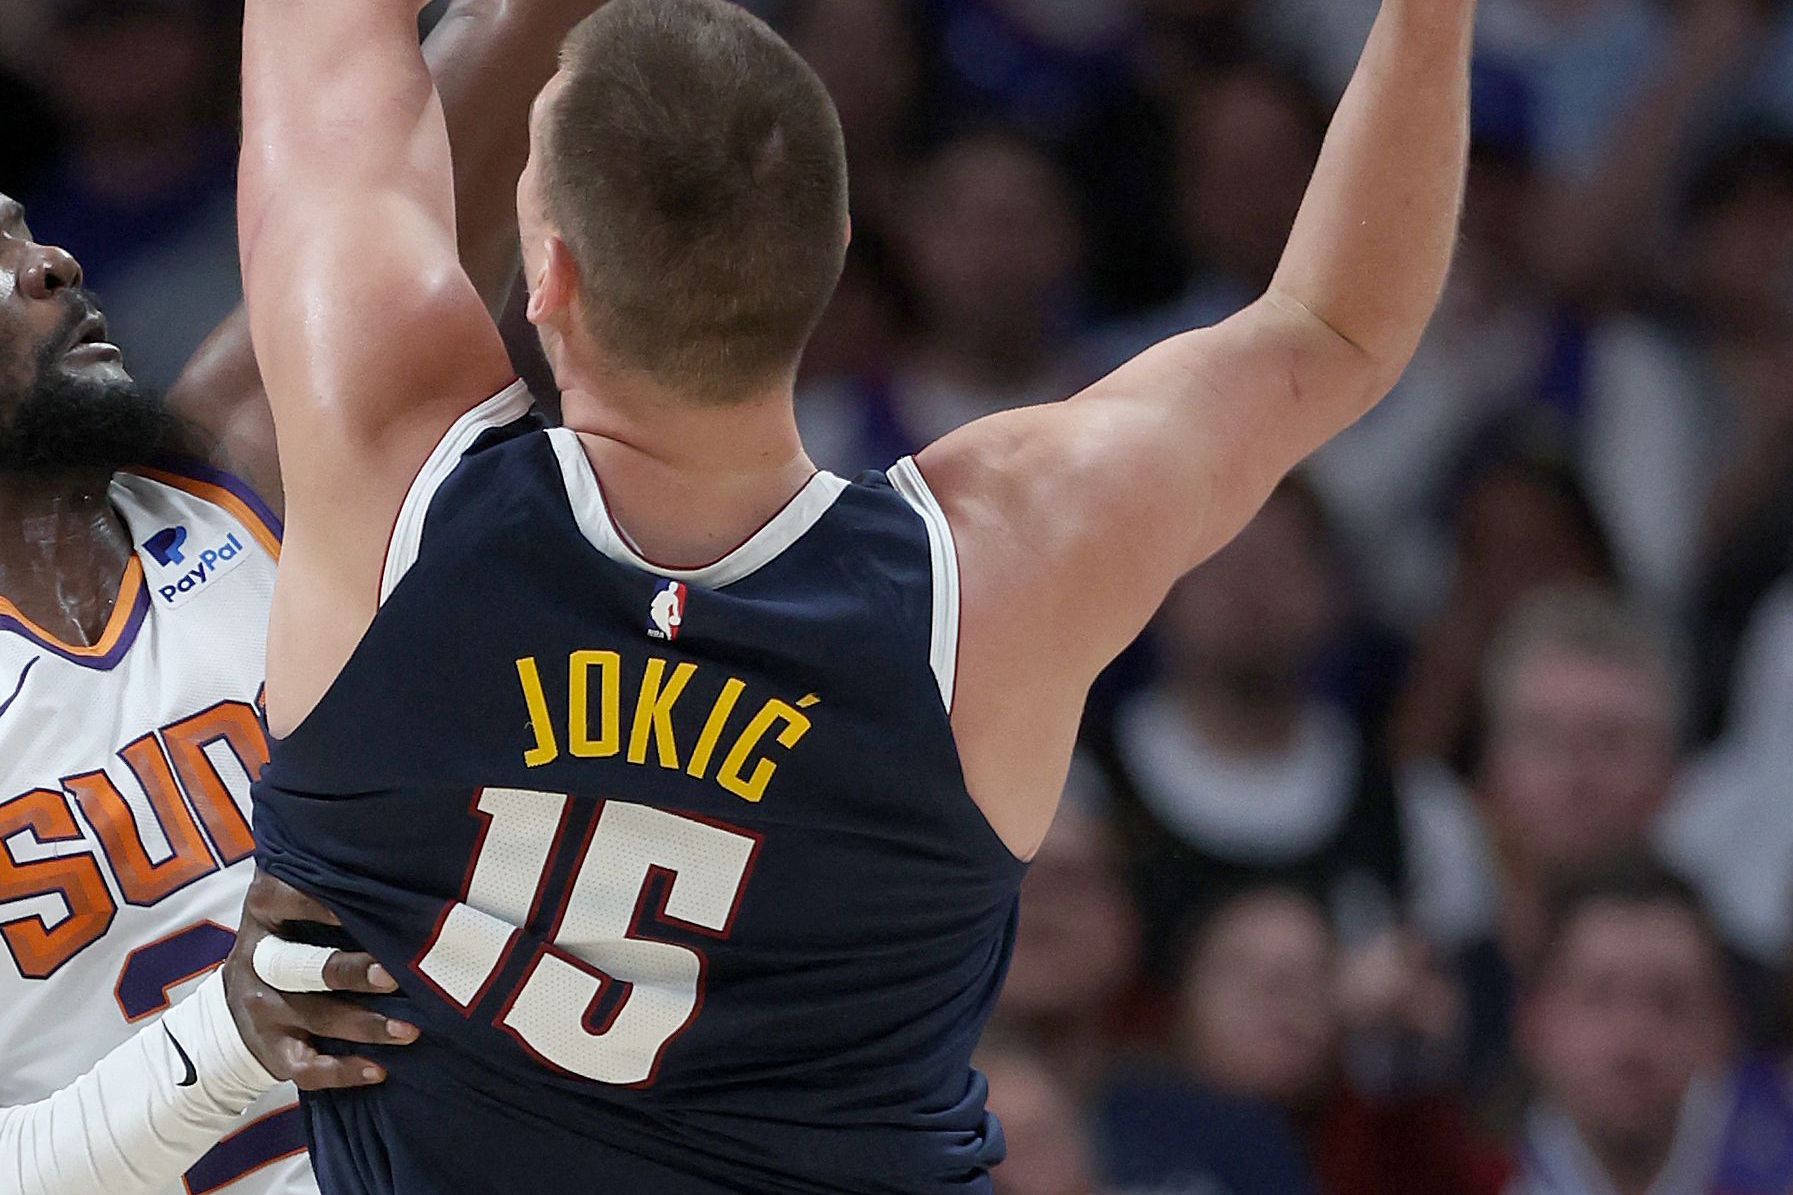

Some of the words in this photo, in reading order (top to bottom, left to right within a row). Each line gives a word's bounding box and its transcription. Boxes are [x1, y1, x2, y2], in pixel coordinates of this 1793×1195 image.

[158, 532, 243, 603] PayPal
[515, 649, 821, 803] JOKIĆ
[409, 785, 765, 1090] 15
